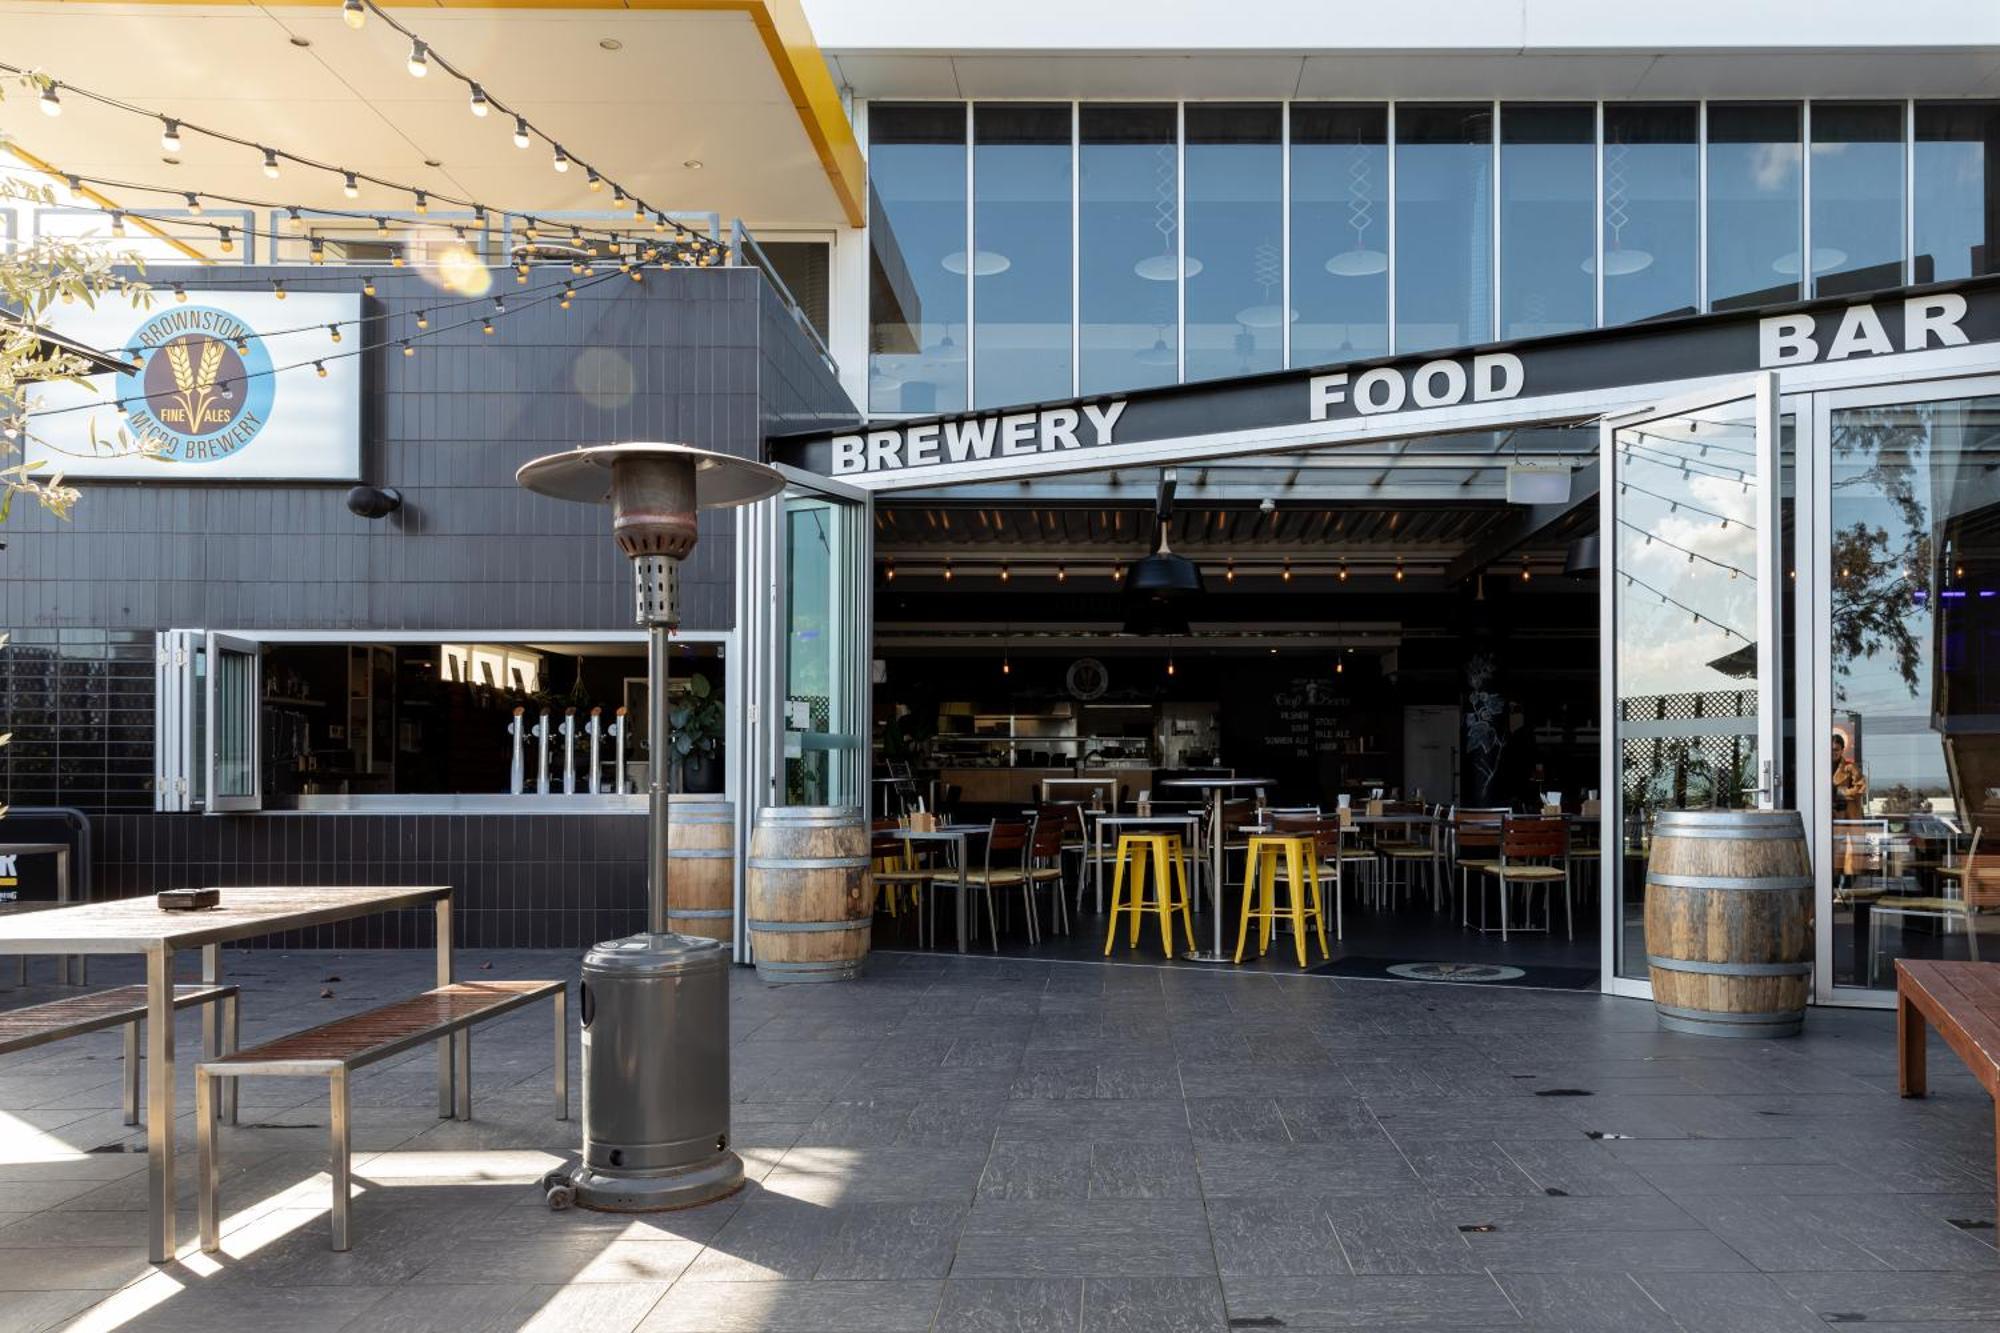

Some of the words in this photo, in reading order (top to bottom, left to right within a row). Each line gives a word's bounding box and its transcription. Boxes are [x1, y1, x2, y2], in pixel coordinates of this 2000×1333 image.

[138, 310, 249, 348] BROWNSTON
[1759, 293, 1970, 368] BAR
[160, 408, 185, 422] FINE
[204, 408, 231, 422] ALES
[1309, 353, 1525, 421] FOOD
[185, 411, 262, 459] BREWERY
[832, 402, 1128, 475] BREWERY
